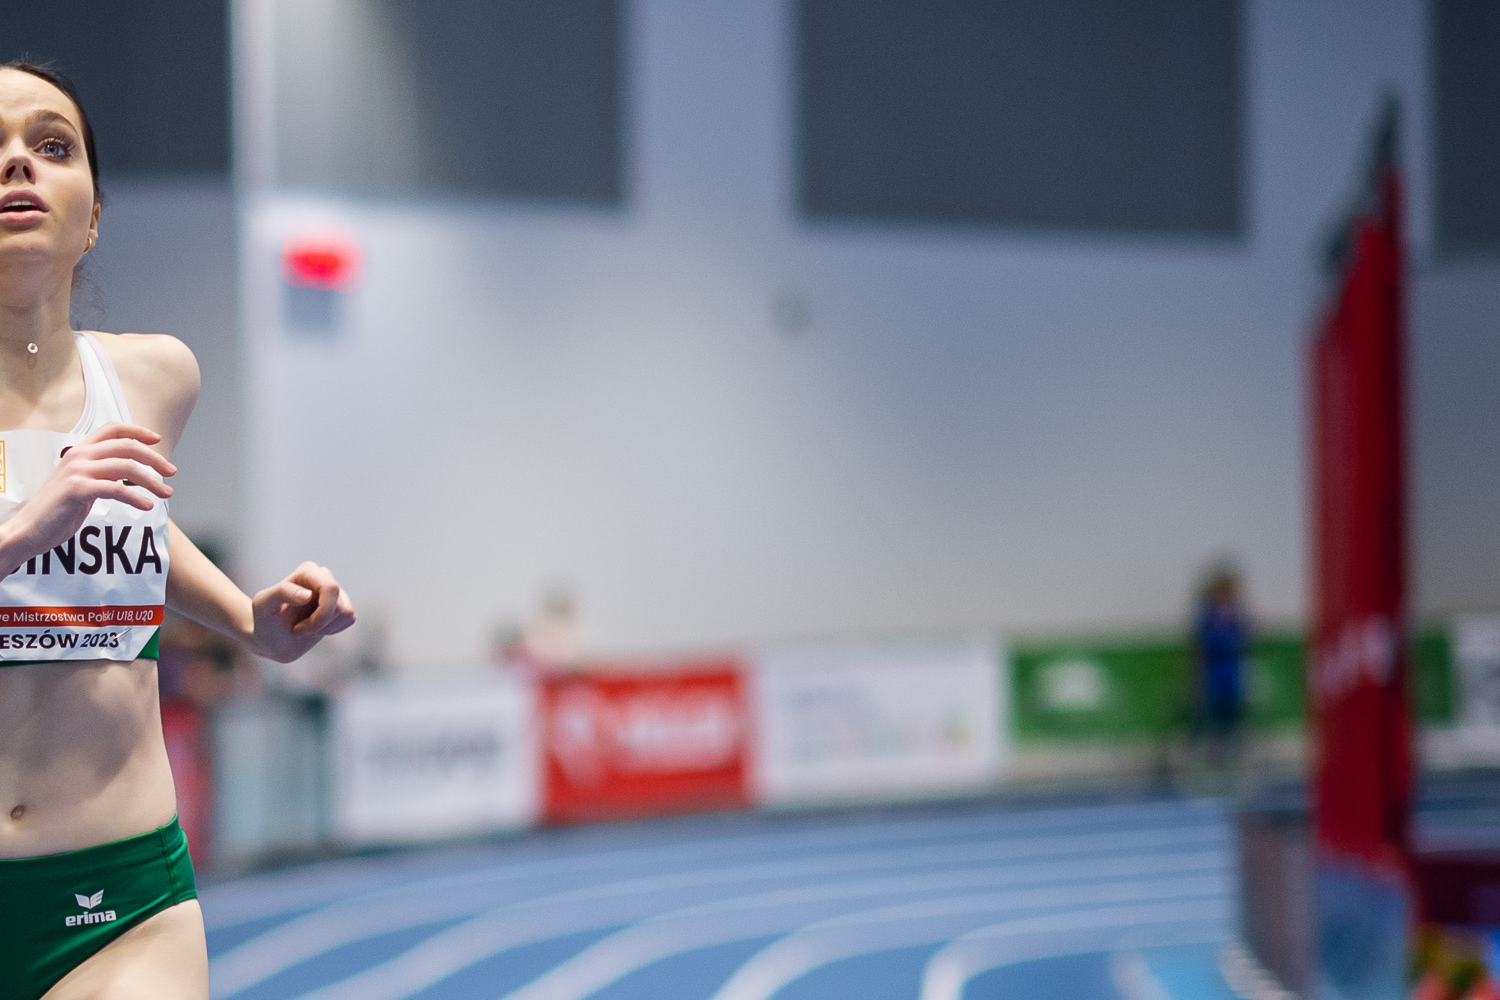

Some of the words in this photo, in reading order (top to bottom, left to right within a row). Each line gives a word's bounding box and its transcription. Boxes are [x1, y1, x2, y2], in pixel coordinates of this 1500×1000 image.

[13, 611, 85, 623] Mistrzostwa
[87, 610, 115, 623] Polski
[80, 632, 119, 648] 2023
[65, 909, 117, 927] erima
